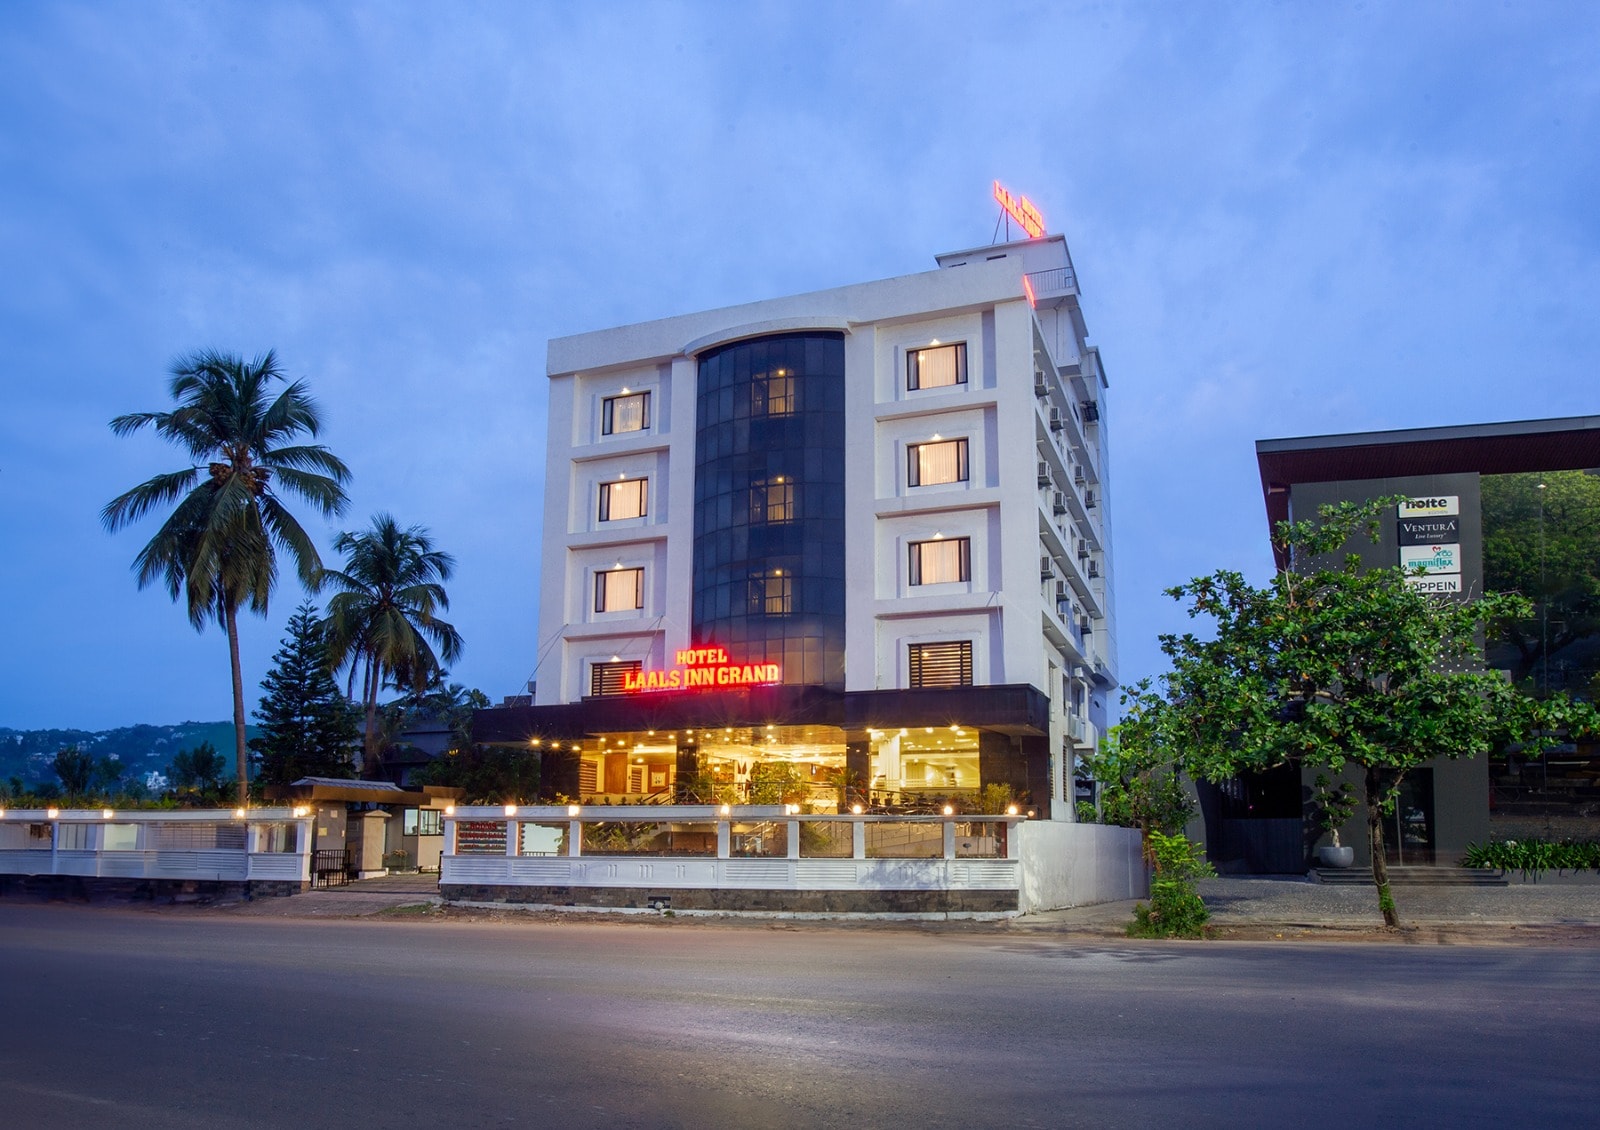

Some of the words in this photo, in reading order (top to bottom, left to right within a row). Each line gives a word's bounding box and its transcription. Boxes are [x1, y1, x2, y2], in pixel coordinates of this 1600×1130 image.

[1403, 522, 1456, 532] VENTURA
[1408, 557, 1453, 568] magniflex
[676, 649, 728, 665] HOTEL
[624, 670, 681, 690] LAALS
[684, 668, 715, 687] INN
[717, 664, 779, 685] GRAND
